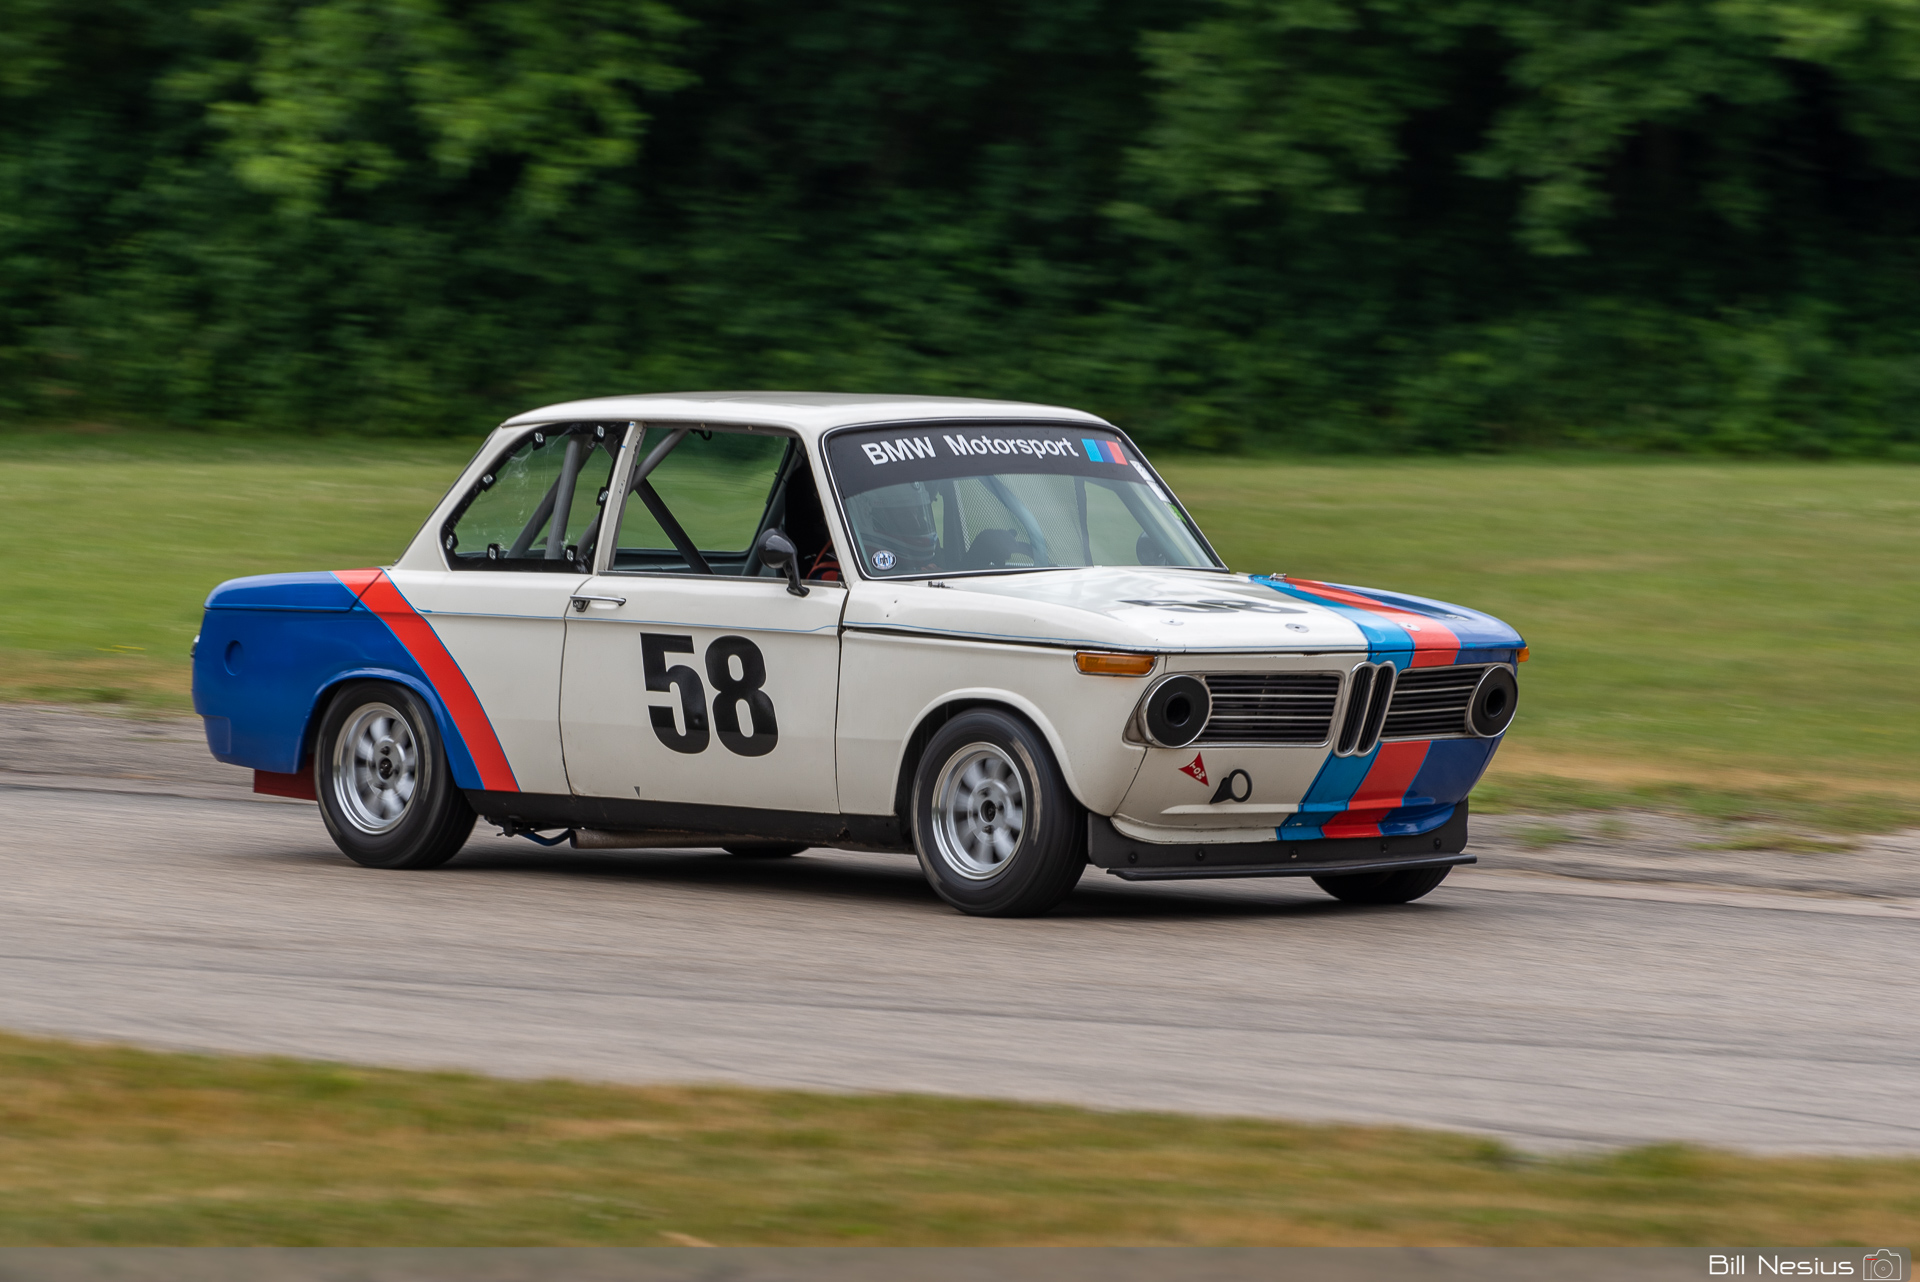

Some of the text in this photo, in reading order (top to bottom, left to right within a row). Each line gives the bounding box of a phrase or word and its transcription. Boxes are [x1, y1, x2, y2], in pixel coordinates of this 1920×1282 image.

[861, 434, 1080, 466] BMW Motorsport
[1117, 600, 1309, 614] 58
[640, 632, 779, 757] 58
[1189, 762, 1205, 780] TOW
